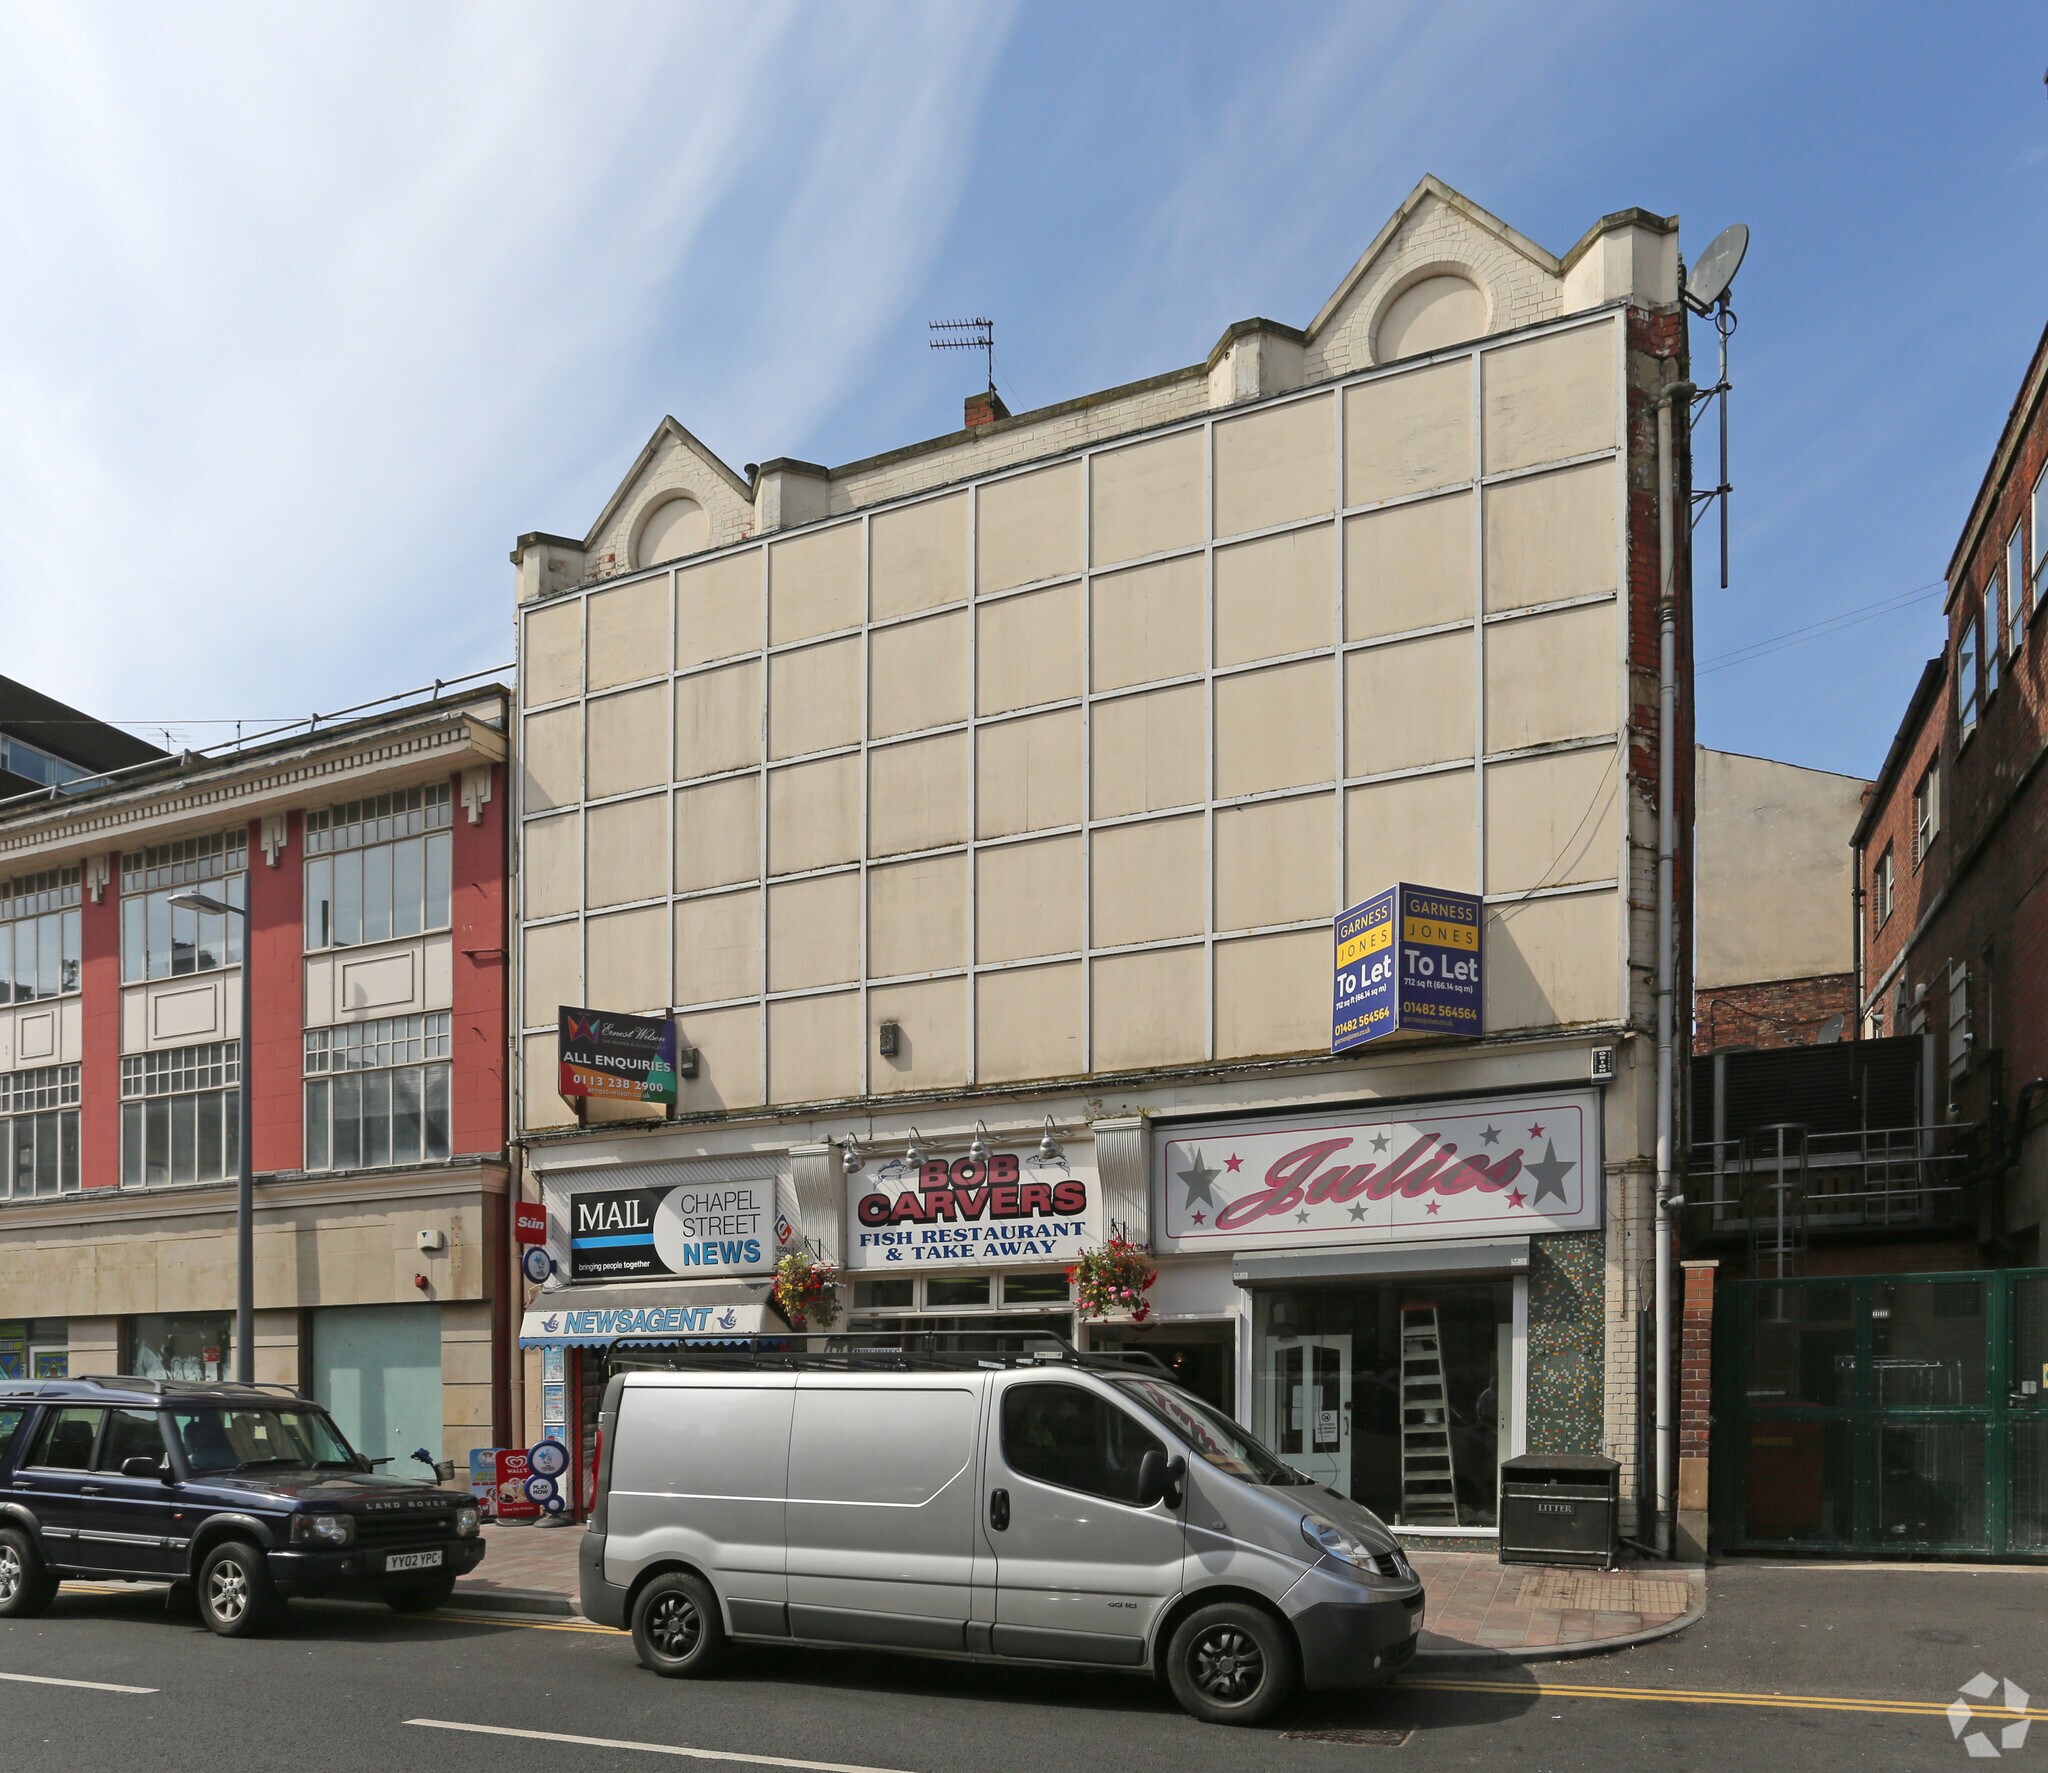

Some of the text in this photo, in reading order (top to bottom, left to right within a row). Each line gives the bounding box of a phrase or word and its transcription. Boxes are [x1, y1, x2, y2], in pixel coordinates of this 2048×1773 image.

[1340, 905, 1388, 938] GARNESS
[1410, 899, 1473, 921] GARNESS
[1340, 929, 1387, 961] JONES
[1410, 924, 1473, 944] JONES
[1336, 954, 1392, 997] To Let
[1404, 949, 1479, 982] To Let
[1404, 978, 1473, 994] 712 sq ft (66.14 sq m)
[1334, 1006, 1390, 1036] 01482 564564
[1403, 1001, 1477, 1020] 01482 564564
[602, 1022, 667, 1042] Ernest Wilson
[563, 1051, 671, 1072] ALL ENQUIRIES
[573, 1074, 663, 1092] 0113 238 2900
[587, 1088, 651, 1099] ernest-wilson.co.uk
[918, 1153, 1020, 1193] BOB
[1215, 1132, 1524, 1230] Julies
[681, 1190, 760, 1214] CHAPEL
[858, 1180, 1087, 1228] CARVERS
[517, 1216, 545, 1230] Sun
[578, 1199, 649, 1232] MAIL
[682, 1213, 761, 1237] STREET
[859, 1222, 1086, 1247] FISH RESTAURANT
[683, 1238, 761, 1266] NEWS
[885, 1240, 1057, 1262] & TAKE AWAY
[578, 1260, 650, 1272] bringing people together
[563, 1308, 713, 1334] NEWSAGENT
[366, 1500, 447, 1510] LAND ROVER
[1538, 1503, 1572, 1513] LITTER
[391, 1552, 438, 1569] YY02 YPC
